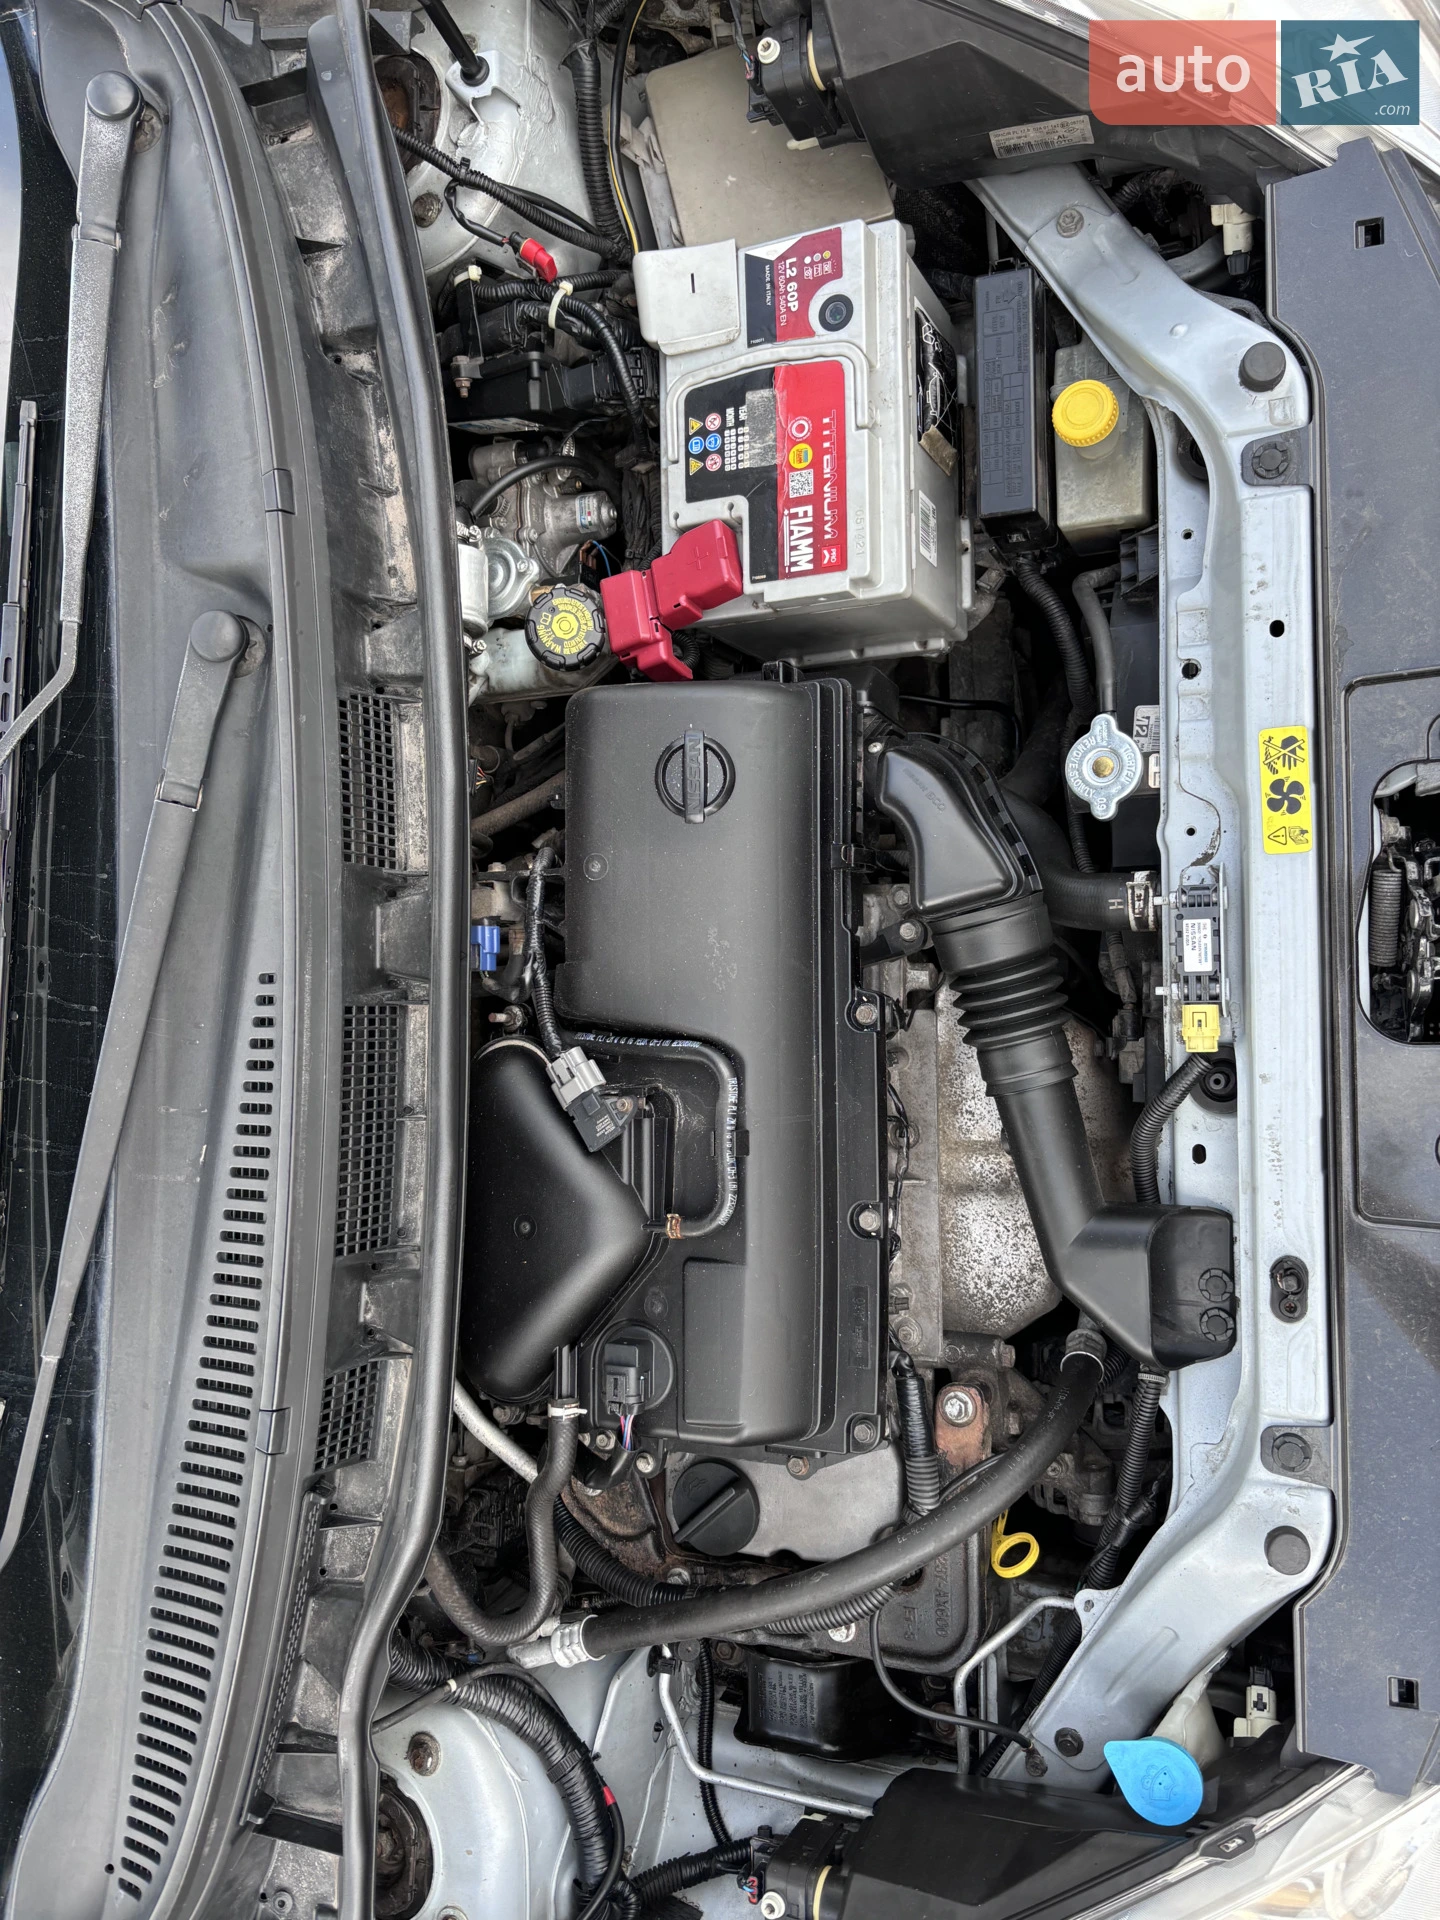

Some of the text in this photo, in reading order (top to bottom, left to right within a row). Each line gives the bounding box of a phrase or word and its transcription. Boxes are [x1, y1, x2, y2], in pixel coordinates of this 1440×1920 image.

[778, 276, 786, 295] 60Ah
[786, 257, 799, 312] L2 60P
[779, 295, 787, 314] 540A
[780, 314, 787, 326] EN
[725, 407, 735, 428] MONTH
[738, 404, 748, 421] YEAR
[822, 409, 839, 539] TITANIUM
[789, 505, 814, 573] FIAMM
[855, 508, 866, 557] 051421
[536, 624, 561, 654] WARNING
[687, 738, 702, 815] NISSAN
[1069, 736, 1096, 799] REMOVE SLOWLY
[1121, 745, 1136, 785] TIGHTEN
[1107, 898, 1124, 910] H
[727, 1077, 739, 1103] TRISTONE
